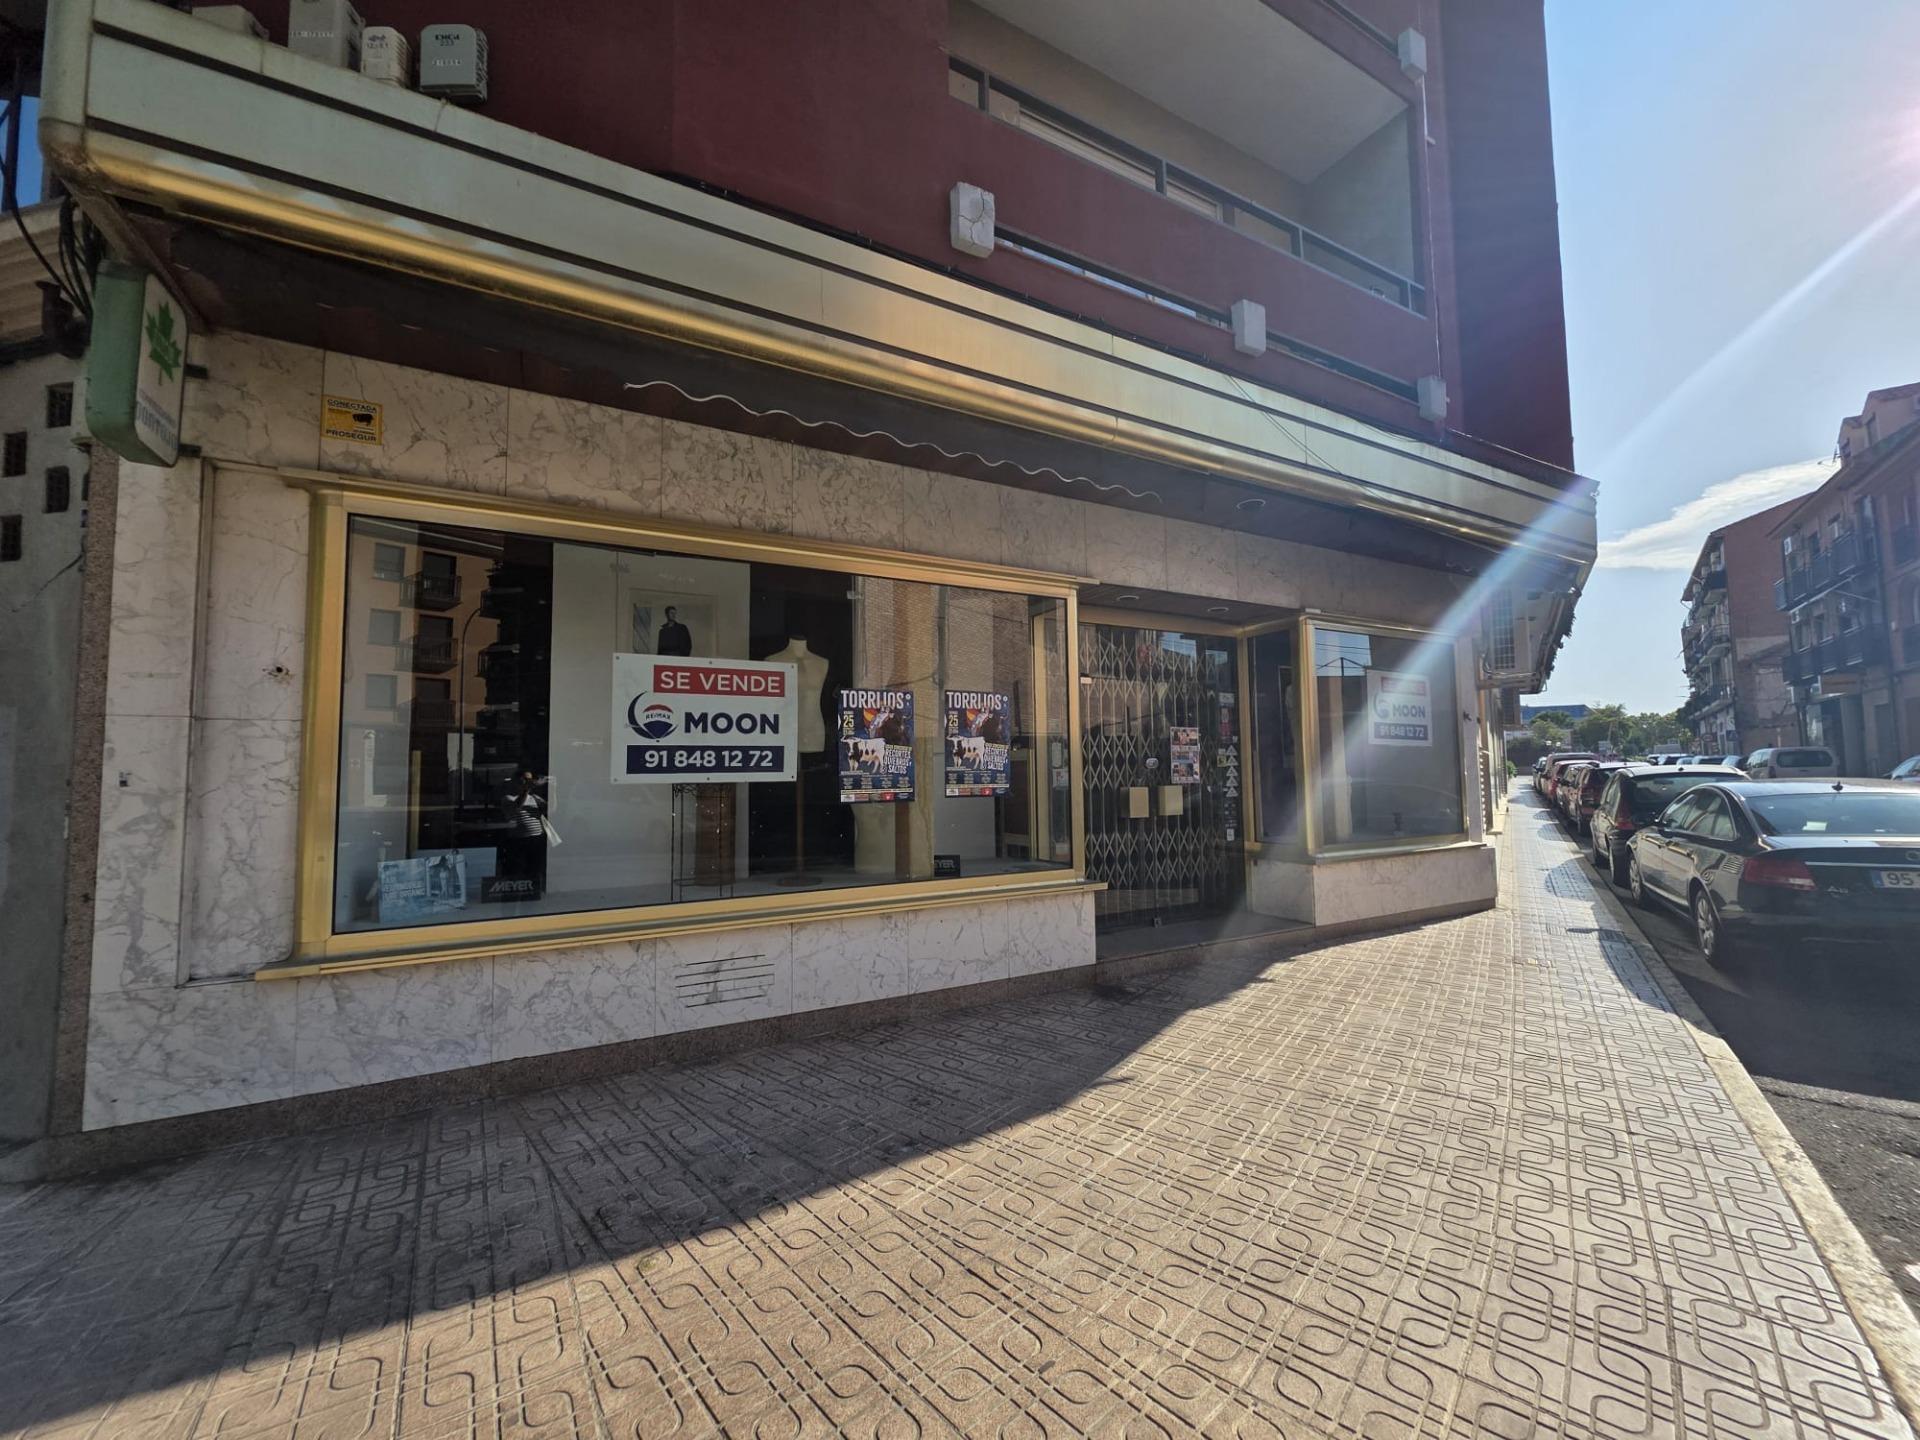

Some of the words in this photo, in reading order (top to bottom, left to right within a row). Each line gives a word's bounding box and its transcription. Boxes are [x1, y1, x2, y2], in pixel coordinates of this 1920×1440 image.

[327, 399, 377, 413] CONECTADA
[326, 429, 377, 441] PROSEGUR
[660, 671, 691, 690] SE
[699, 672, 781, 693] VENDE
[841, 690, 904, 709] TORRIJOS
[946, 692, 1002, 710] TORRIJOS
[1393, 704, 1426, 718] MOON
[684, 711, 780, 735] MOON
[843, 714, 855, 728] 25
[948, 714, 959, 727] 25
[1415, 726, 1425, 737] 72
[644, 750, 668, 767] 91
[674, 750, 716, 768] 848
[721, 750, 743, 767] 12
[749, 750, 773, 767] 72
[489, 879, 535, 892] MEYER
[1886, 872, 1920, 886] 95
